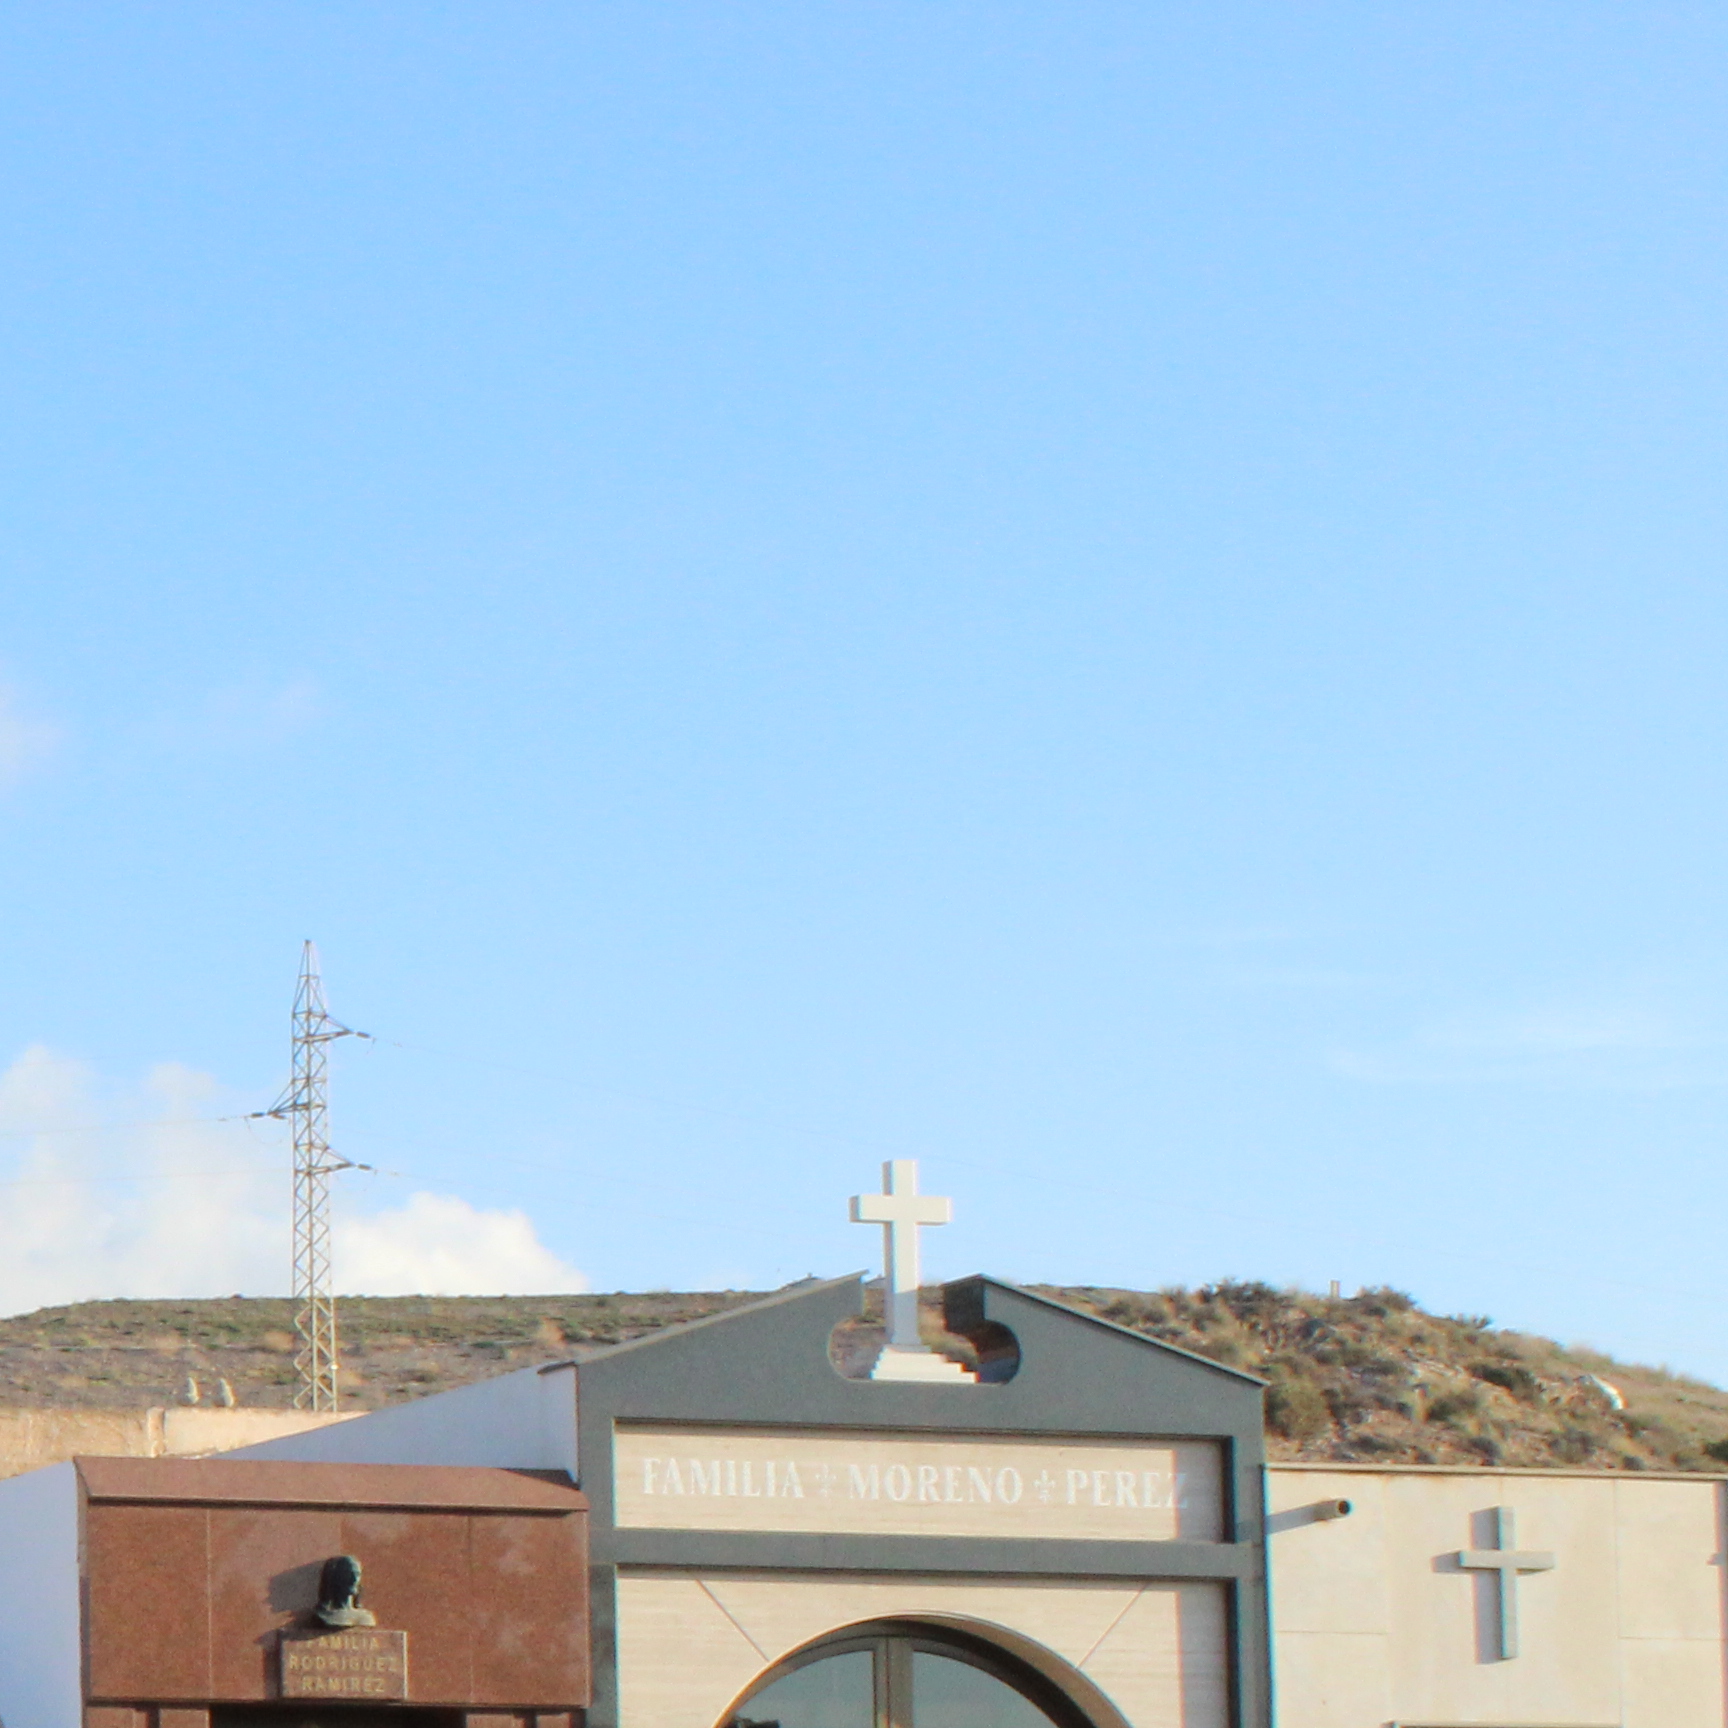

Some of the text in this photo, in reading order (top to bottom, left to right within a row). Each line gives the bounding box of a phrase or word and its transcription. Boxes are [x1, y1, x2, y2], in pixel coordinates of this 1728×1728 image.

[643, 1457, 1189, 1510] FAMILIA MORENO PEREZ
